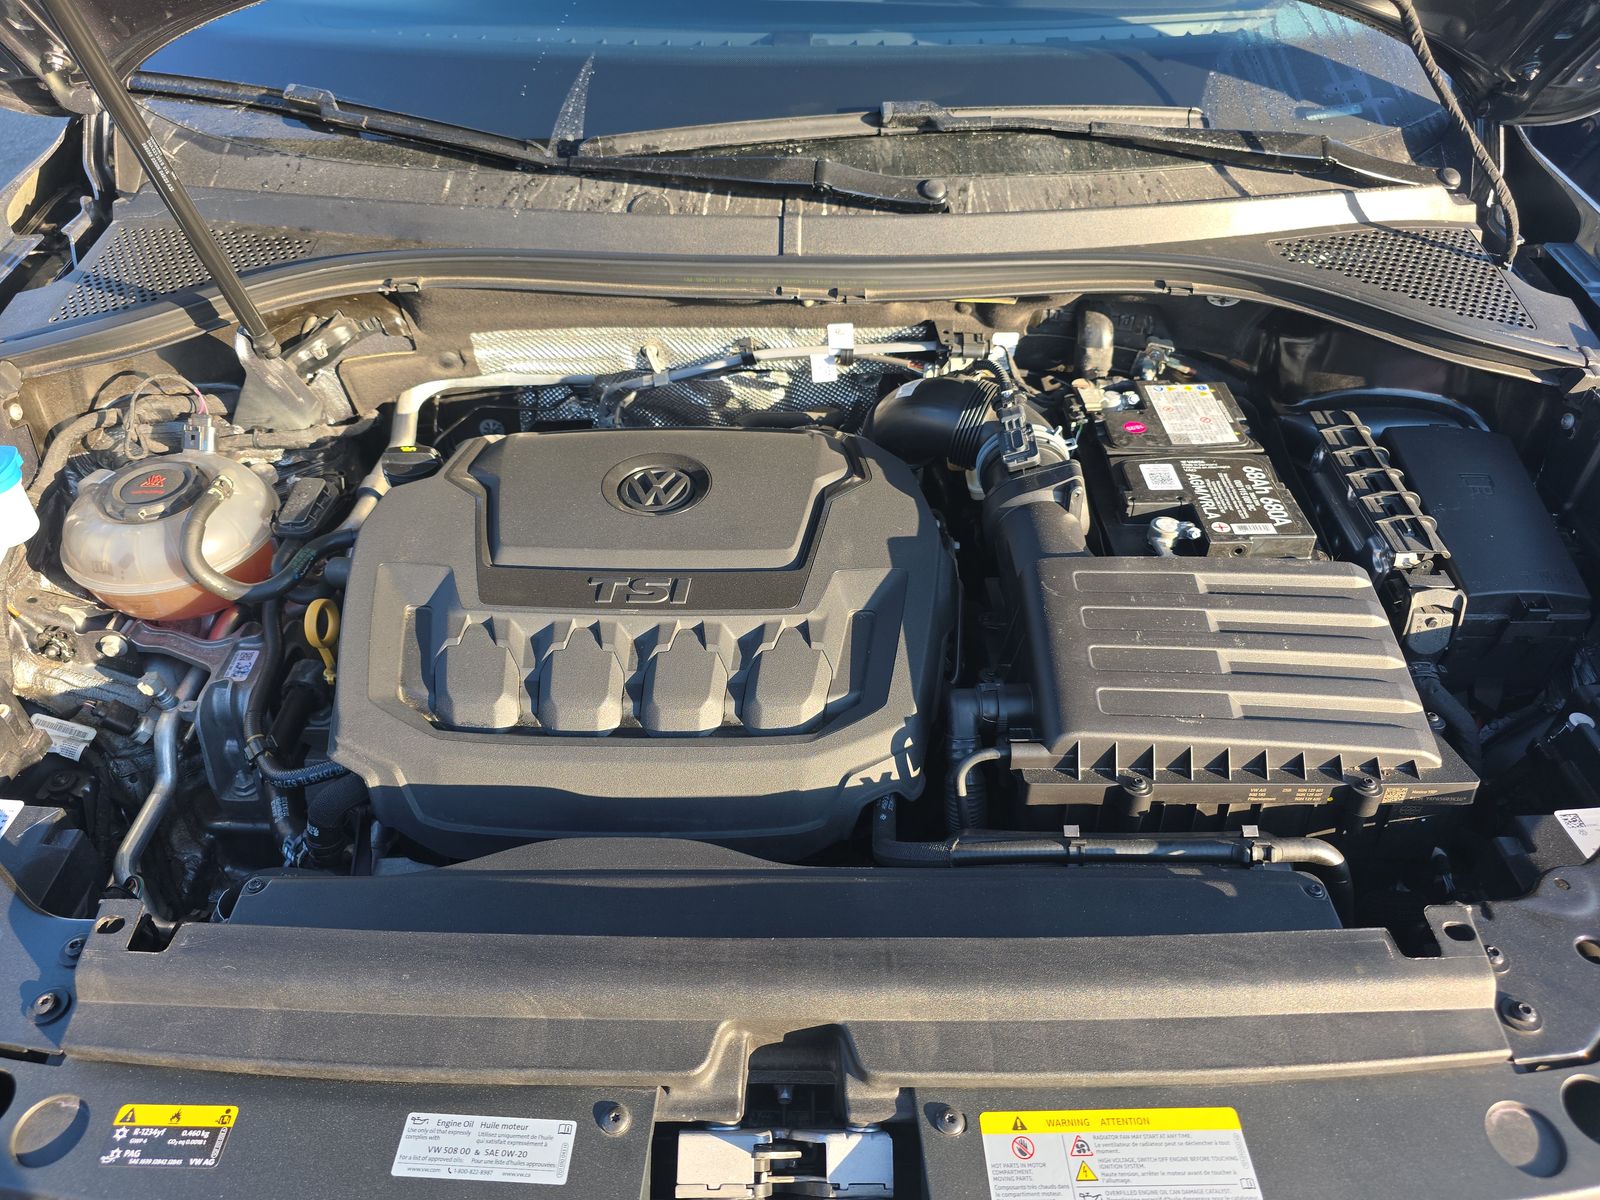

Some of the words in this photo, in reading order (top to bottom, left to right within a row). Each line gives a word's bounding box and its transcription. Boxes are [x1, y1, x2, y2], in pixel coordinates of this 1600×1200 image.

[1242, 466, 1273, 494] 68Ah
[1260, 497, 1292, 526] 680A
[587, 576, 692, 604] TSI
[437, 1119, 461, 1128] Engine
[1046, 1119, 1090, 1127] WARNING
[1100, 1117, 1150, 1126] ATTENTION
[133, 1128, 167, 1138] R-1234yf
[201, 1130, 210, 1138] kg
[123, 1150, 142, 1158] PAG
